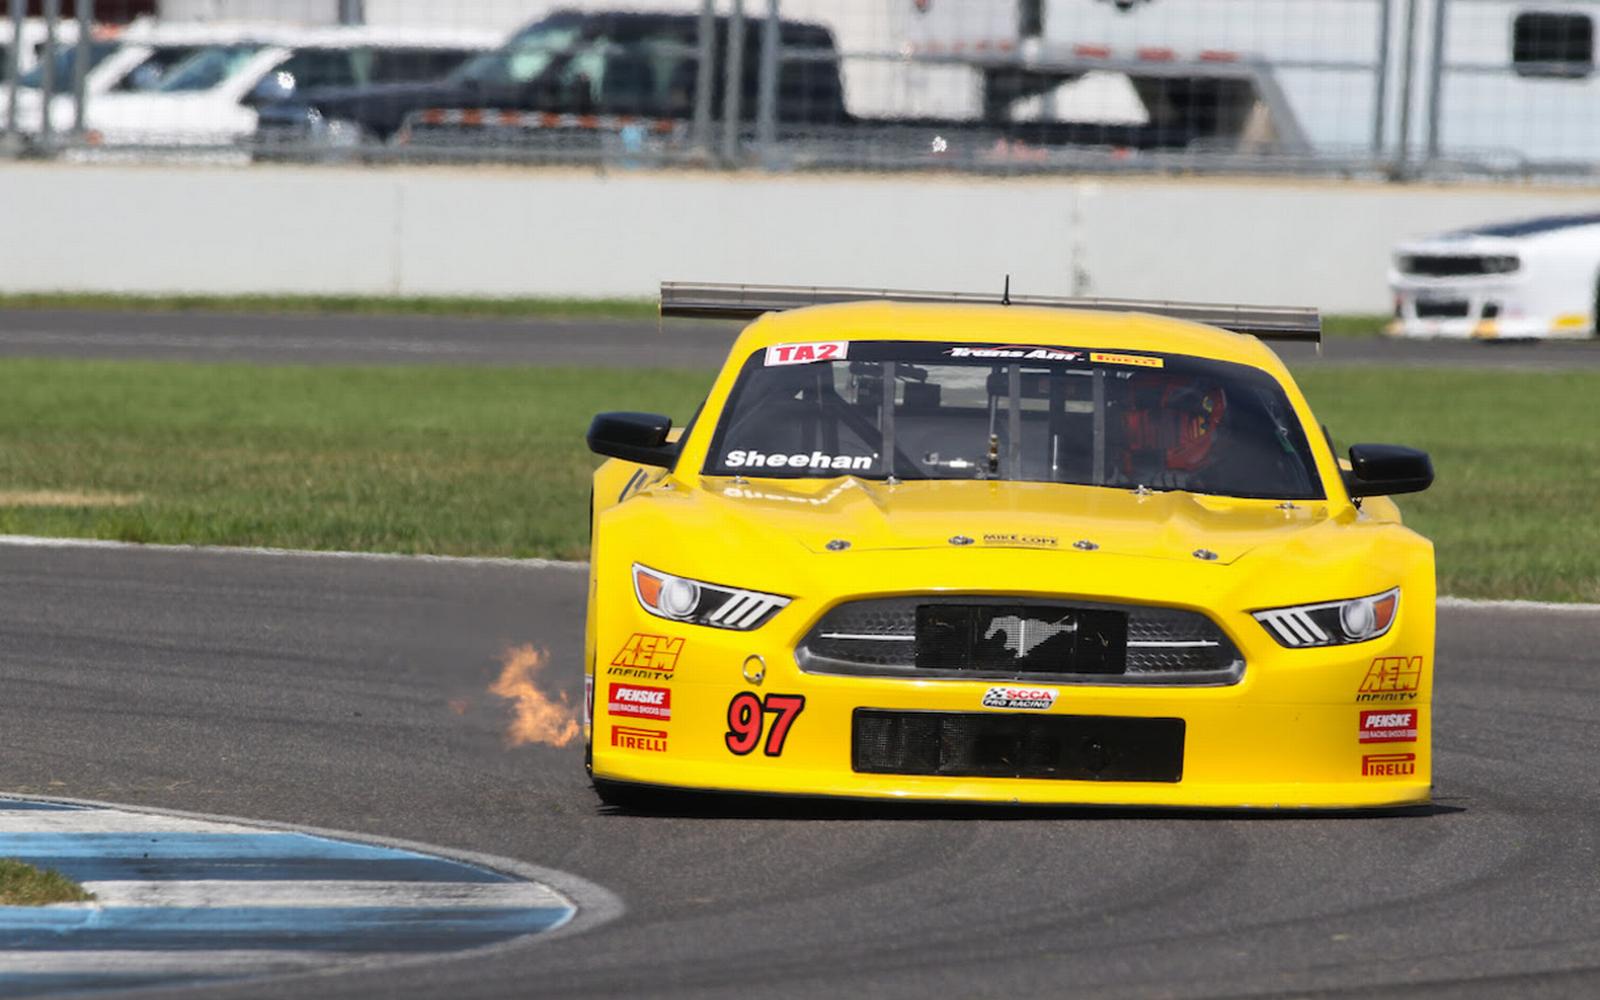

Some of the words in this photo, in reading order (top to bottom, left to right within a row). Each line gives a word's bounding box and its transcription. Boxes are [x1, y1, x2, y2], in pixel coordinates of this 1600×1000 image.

[776, 344, 839, 361] TA2
[950, 347, 1023, 358] Trans
[1024, 349, 1076, 361] Am
[725, 450, 873, 469] Sheehan
[610, 632, 686, 672] AEM
[607, 667, 674, 680] INFINITY
[1358, 656, 1423, 692] AEM
[615, 688, 666, 704] PENSKE
[1006, 690, 1052, 700] SCCA
[1356, 693, 1418, 702] INFINITY
[1009, 700, 1050, 708] RACING
[725, 691, 806, 757] 97
[1365, 713, 1412, 728] PENSKE
[611, 725, 668, 752] PIRELLI
[1362, 753, 1416, 776] PIRELLI
